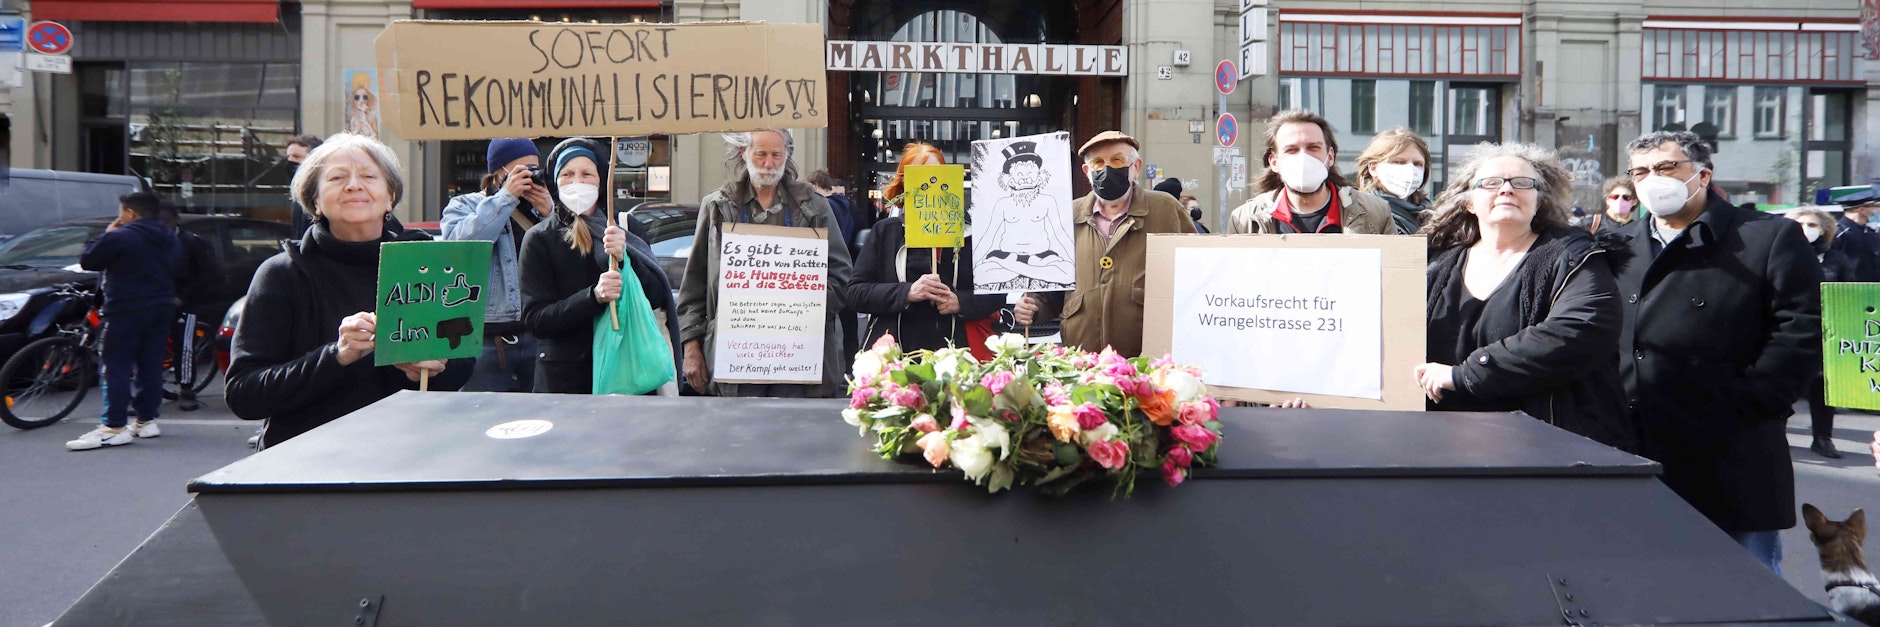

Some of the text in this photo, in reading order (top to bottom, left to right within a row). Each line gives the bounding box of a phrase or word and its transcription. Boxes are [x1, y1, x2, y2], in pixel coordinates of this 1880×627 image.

[528, 28, 676, 74] SOFORT
[829, 42, 1123, 74] MARKTHALLE
[1178, 52, 1188, 62] 42
[416, 69, 819, 130] REKOMMUNALISIERUNG!!
[914, 193, 961, 209] BLIND
[922, 222, 956, 235] KIEZ
[723, 241, 820, 257] Es gibt zwei
[727, 256, 828, 269] Sorten von Ratten
[724, 269, 819, 283] Die Hungrigen
[726, 279, 826, 291] und die Satten
[384, 282, 437, 307] ALDI
[1204, 294, 1337, 311] Vorkaufsrecht für
[1198, 313, 1343, 333] Wrangelstrasse 23!
[727, 341, 805, 352] Verdrängung hat
[729, 363, 744, 374] Der
[745, 363, 771, 376] Kampf
